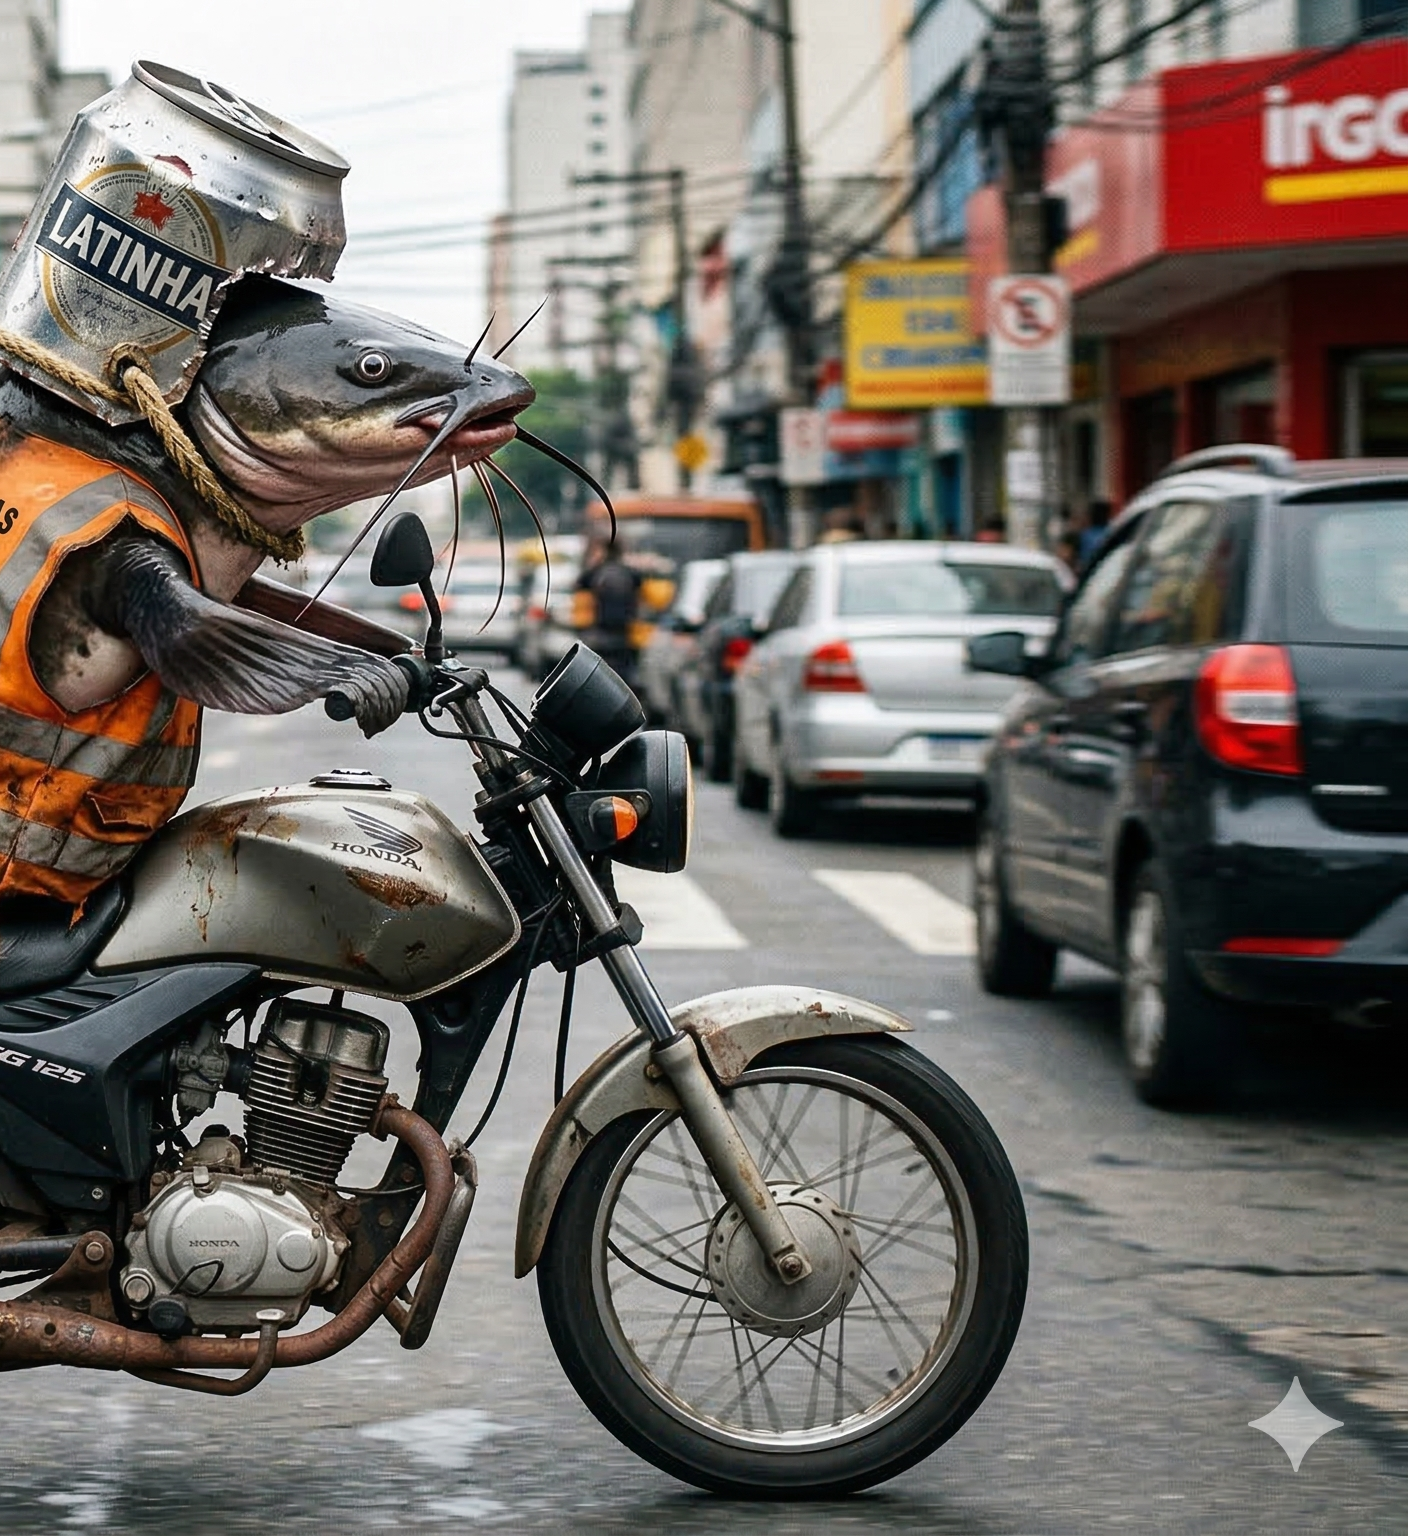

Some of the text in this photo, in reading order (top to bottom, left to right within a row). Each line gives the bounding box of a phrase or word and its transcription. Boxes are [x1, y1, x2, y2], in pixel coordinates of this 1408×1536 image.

[48, 197, 214, 321] LATINHA
[330, 841, 422, 872] HONDA
[31, 1058, 86, 1084] 125
[188, 1239, 240, 1248] HONDA
